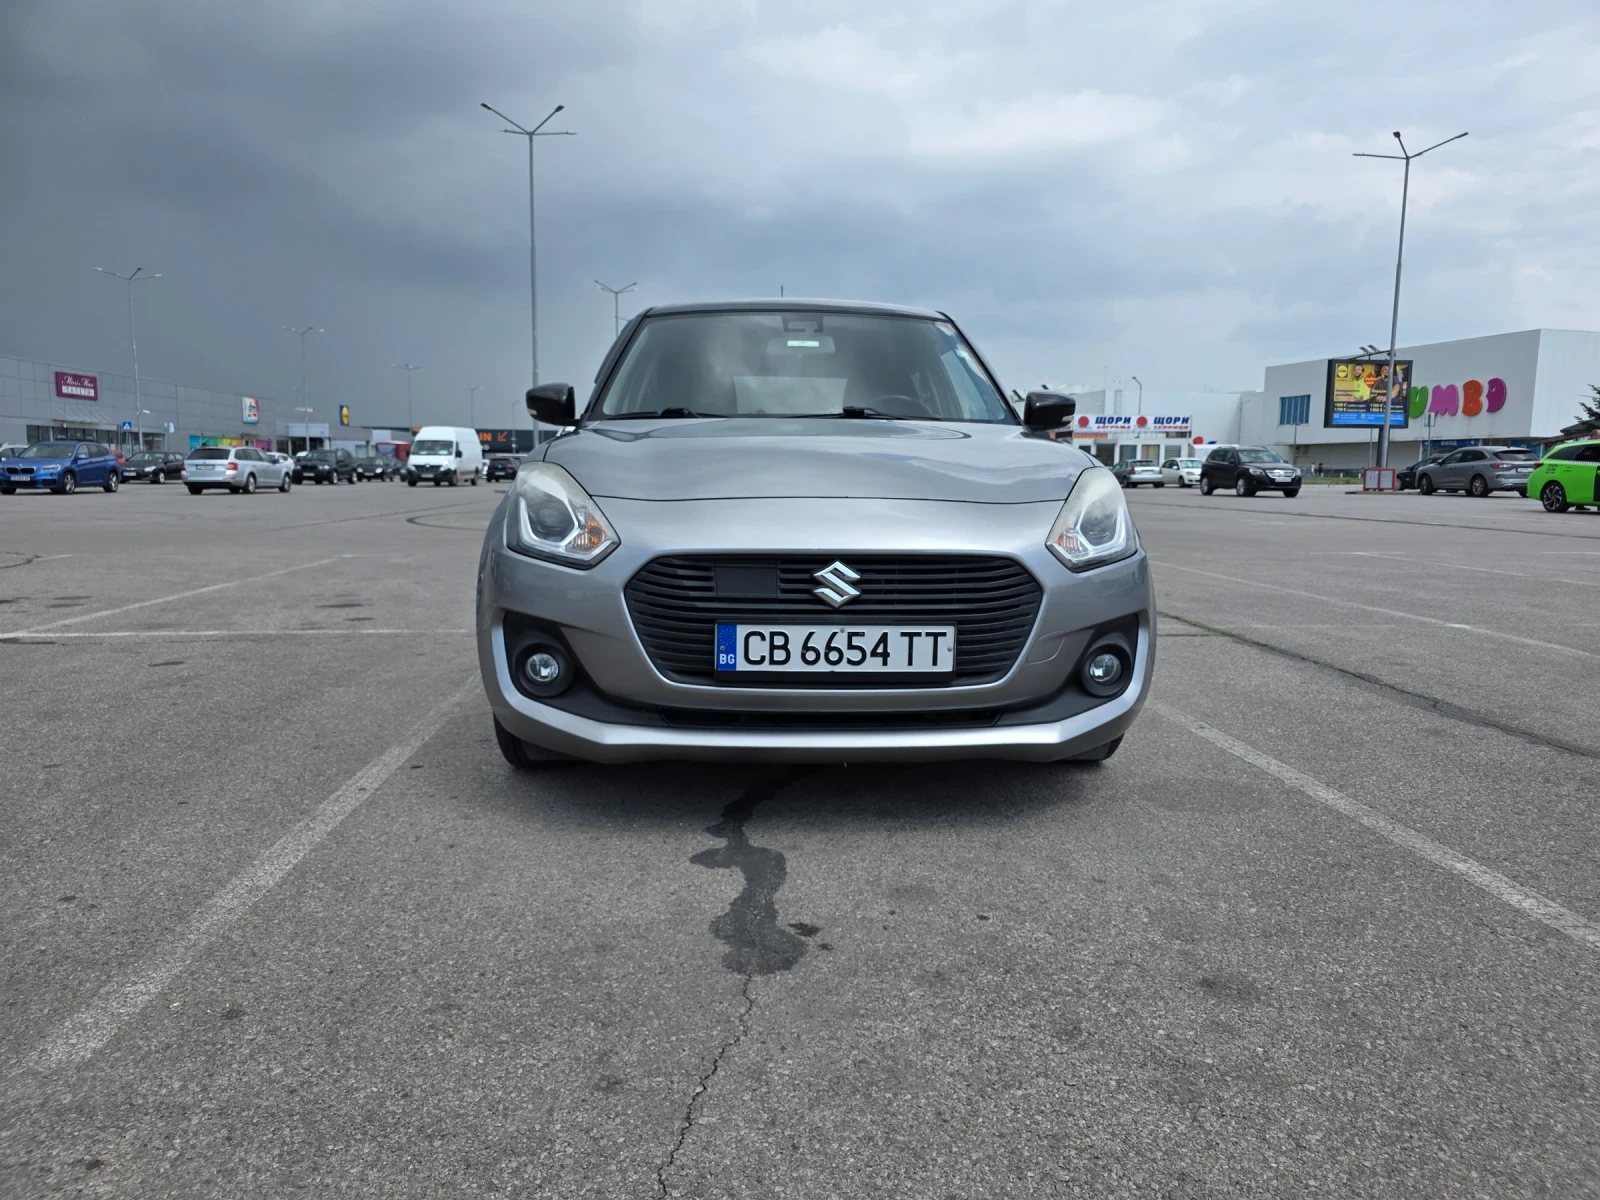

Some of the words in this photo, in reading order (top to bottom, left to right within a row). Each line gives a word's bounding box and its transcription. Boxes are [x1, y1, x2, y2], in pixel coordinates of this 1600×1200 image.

[1410, 377, 1507, 419] UMBO
[1095, 416, 1131, 425] ЩОРИ
[1153, 416, 1189, 425] ЩОРИ
[743, 630, 791, 666] CB
[800, 630, 891, 667] 6654
[900, 631, 948, 667] TT
[719, 653, 735, 665] BG
